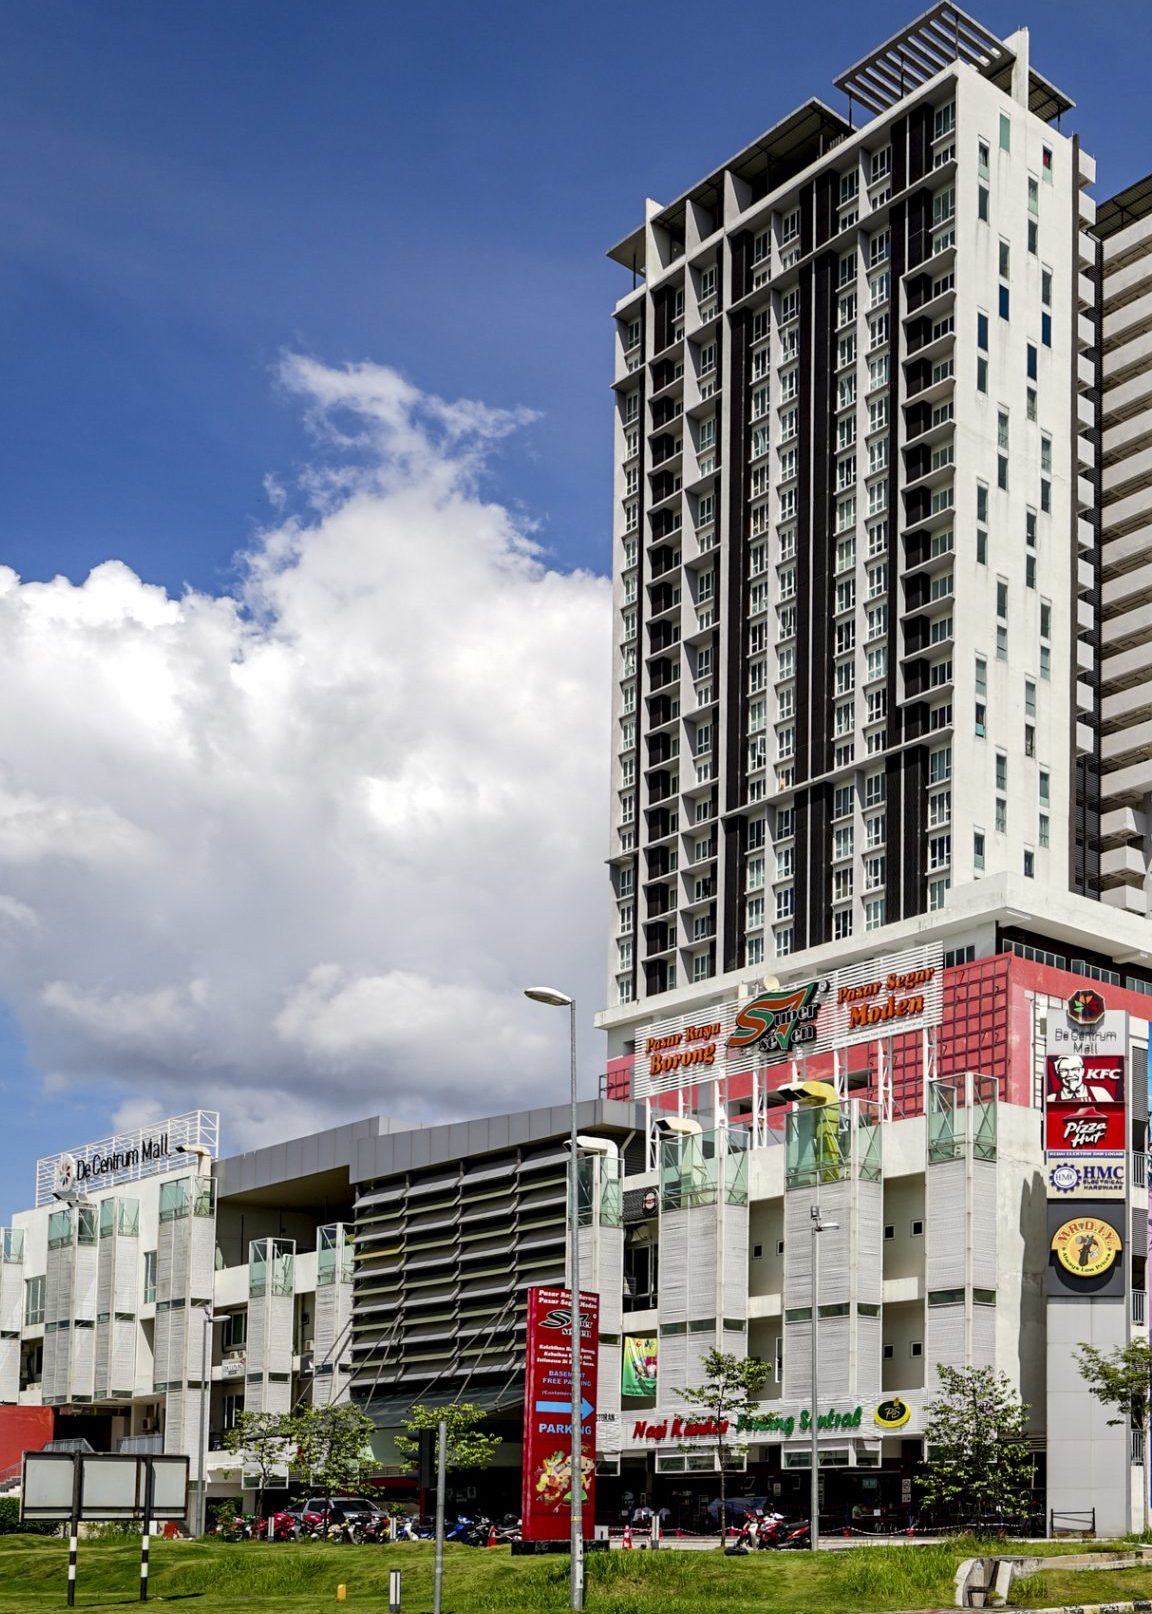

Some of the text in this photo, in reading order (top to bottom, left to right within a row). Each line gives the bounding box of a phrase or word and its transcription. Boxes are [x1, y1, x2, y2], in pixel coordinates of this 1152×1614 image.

[837, 966, 935, 1005] Pasar Segar
[848, 995, 924, 1029] Moden
[644, 1022, 721, 1053] Pasar Raya
[1055, 1028, 1117, 1041] De Centrum
[1073, 1042, 1098, 1054] Mall
[650, 1043, 716, 1075] Borong
[1085, 1068, 1122, 1079] KFC
[1063, 1120, 1107, 1138] Pizza
[1071, 1132, 1105, 1148] Hut
[77, 1133, 169, 1180] De Centrum Mall
[1056, 1173, 1075, 1181] HMC
[1083, 1166, 1124, 1179] HMC
[539, 1290, 559, 1298] Pasar
[562, 1328, 591, 1337] seen
[563, 1379, 591, 1387] PAING
[538, 1423, 592, 1435] PARKNG
